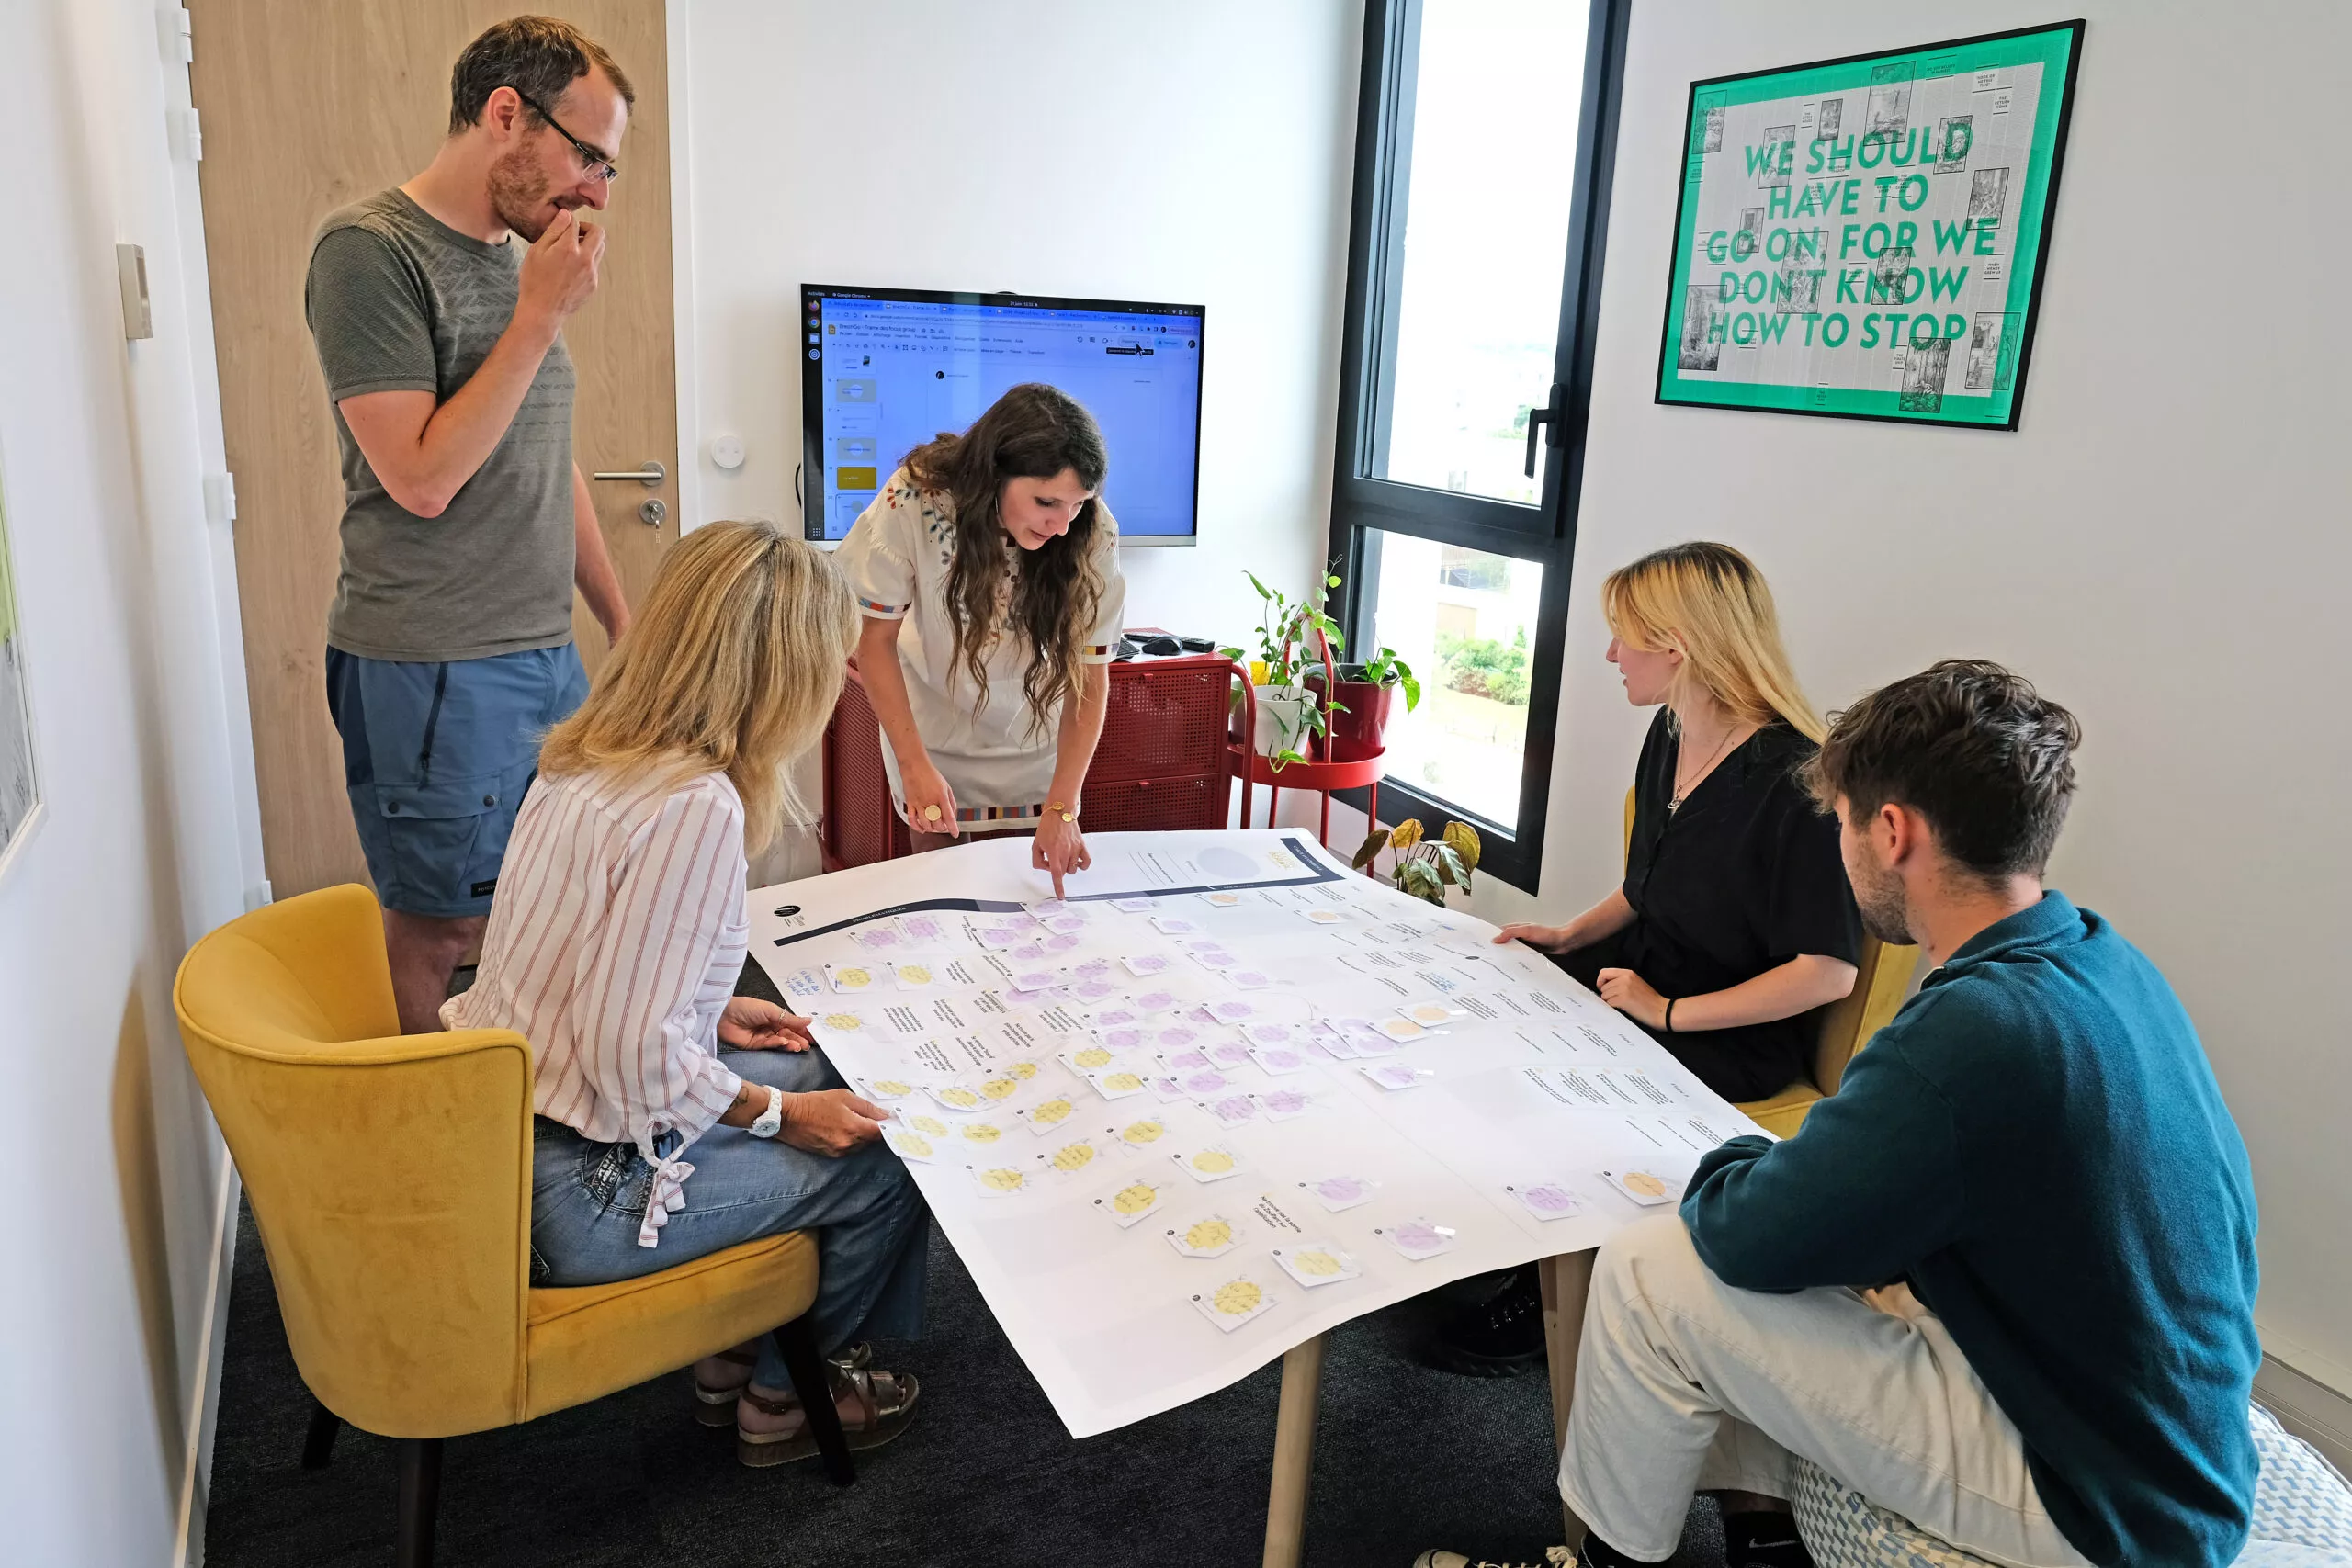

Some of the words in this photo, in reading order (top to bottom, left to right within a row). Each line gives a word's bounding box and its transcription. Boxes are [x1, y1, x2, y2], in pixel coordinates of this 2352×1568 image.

[1745, 141, 1796, 178] WE
[1806, 121, 1974, 174] SHOULD
[1768, 178, 1861, 221] HAVE
[1874, 173, 1929, 213] TO
[1707, 230, 1755, 264] GO
[1839, 221, 1918, 260] FOR
[1932, 218, 1999, 256] WE
[1836, 265, 1970, 305] KNOW
[1707, 312, 1791, 346] HOW
[1802, 312, 1849, 347] TO
[1860, 312, 1967, 351] STOP
[1263, 1207, 1281, 1223] ZooParc
[1265, 1201, 1280, 1212] trouve
[1288, 1221, 1302, 1233] sortie
